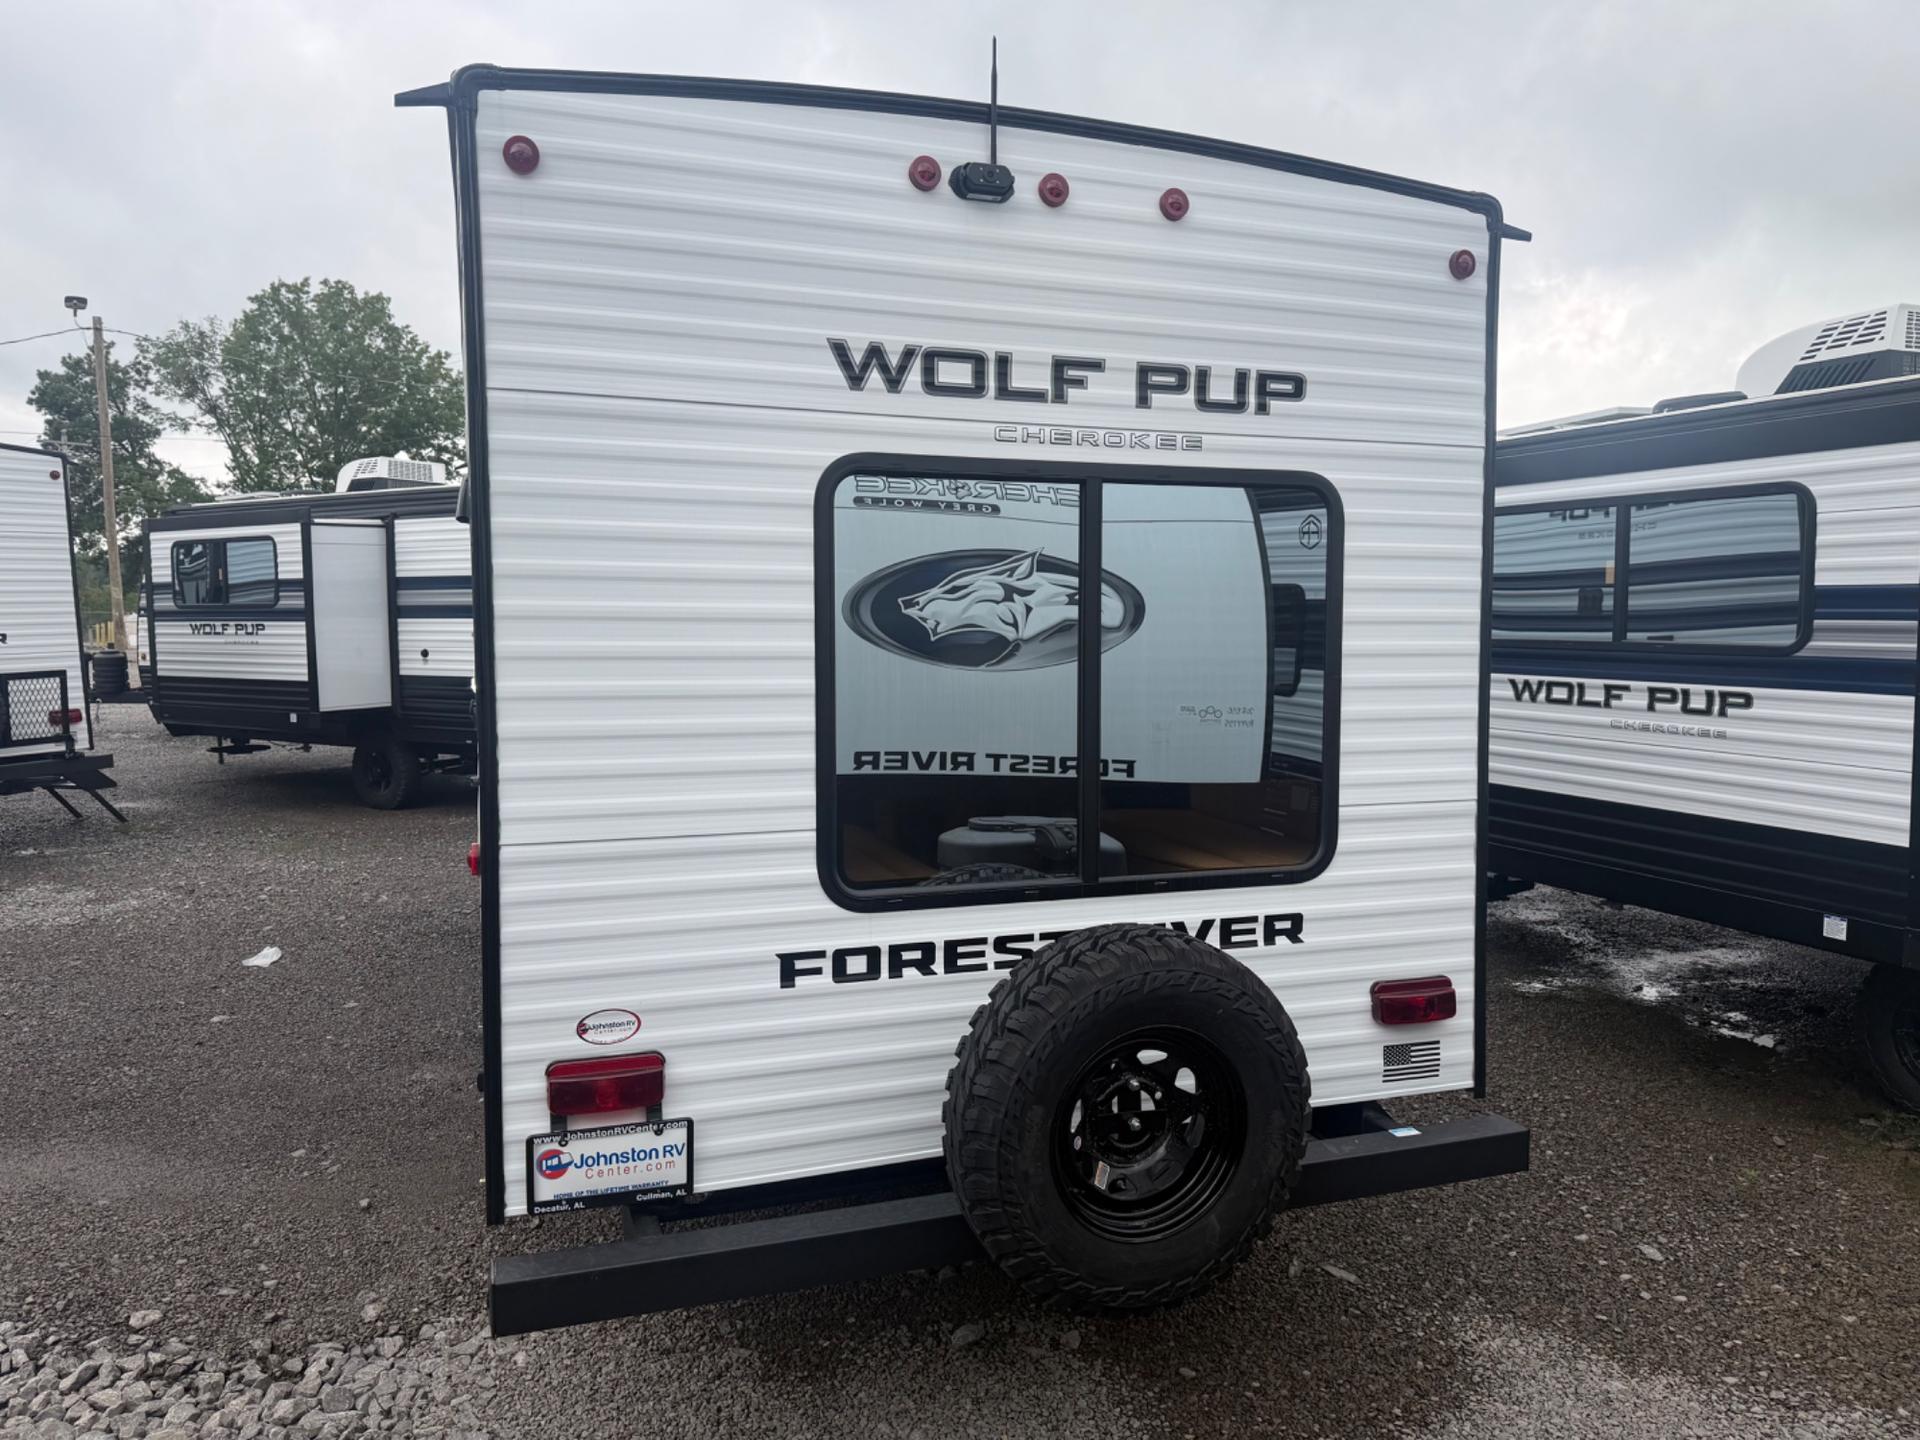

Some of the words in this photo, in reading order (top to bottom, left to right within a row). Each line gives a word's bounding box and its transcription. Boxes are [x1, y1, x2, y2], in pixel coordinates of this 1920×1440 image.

[827, 337, 1106, 404] WOLF
[1135, 361, 1307, 415] PUP
[994, 425, 1203, 451] CHEROKEE
[189, 623, 230, 636] WOLF
[234, 623, 266, 636] PUP
[1508, 678, 1631, 709] WOLF
[1646, 685, 1754, 718] PUP
[1609, 719, 1727, 739] CHEROKEE
[1156, 912, 1304, 950] VER
[533, 1120, 688, 1145] wwwJohnstonRVCenter.com
[574, 1147, 659, 1169] Johnston
[663, 1143, 685, 1158] RV
[585, 1160, 676, 1180] Center.com
[553, 1192, 574, 1200] HOME
[631, 1180, 669, 1190] WARRANTY
[676, 1188, 688, 1196] AL
